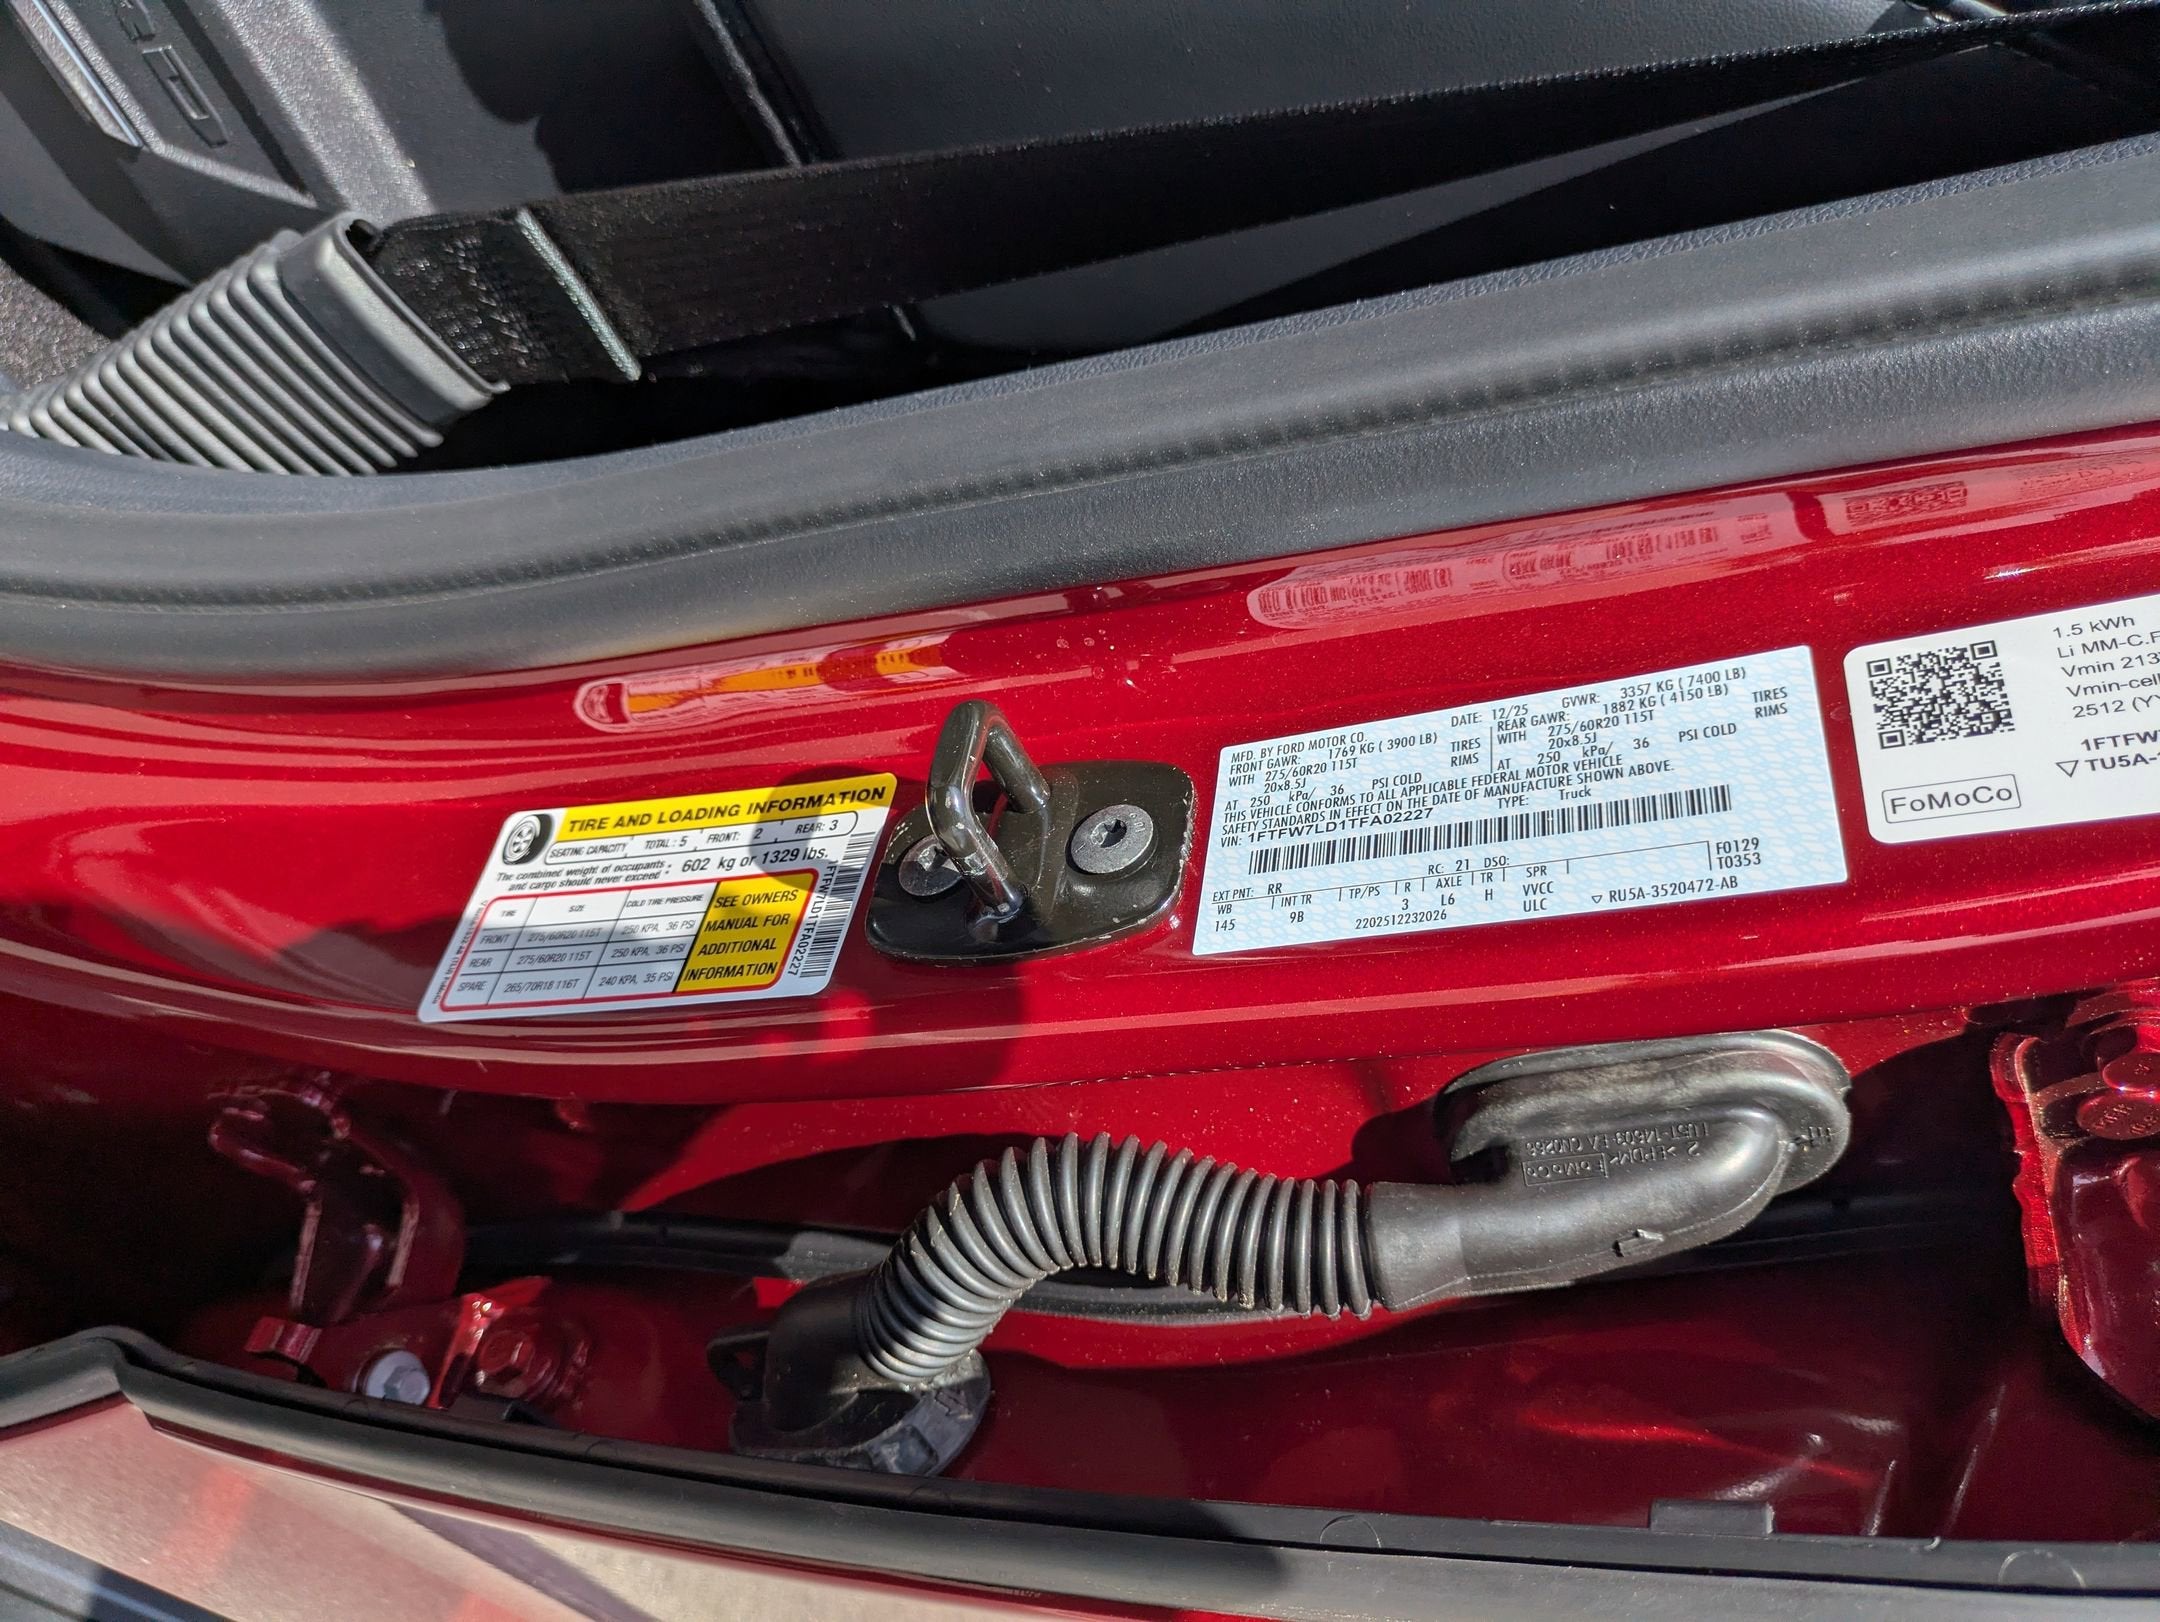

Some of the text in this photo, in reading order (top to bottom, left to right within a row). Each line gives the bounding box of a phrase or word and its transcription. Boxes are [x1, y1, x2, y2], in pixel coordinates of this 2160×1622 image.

[2053, 616, 2135, 638] 1.5 kWh
[2058, 645, 2074, 658] Li
[2061, 652, 2160, 677] Vmin 213
[1562, 667, 1746, 708] GVWR: 3357 KG 7400 LB)
[1451, 704, 1528, 727] DATE: 12/25
[1497, 684, 1729, 732] REAR GAWR: 1882 KG 4150 LB)
[1497, 687, 1788, 745] WITH 275/60R20 115T TIRES
[2073, 700, 2125, 718] 2512
[1549, 703, 1788, 750] 20x8.5J RIMS
[1230, 732, 1438, 775] FRONT GAWR: 1769 KG 3900 LB)
[1231, 732, 1367, 763] MFD. BY FORD MOTOR CO.
[1498, 723, 1737, 771] AT 250 kPa/ 36 PSI COLD
[2081, 730, 2160, 751] 1FTFW
[1229, 738, 1481, 787] WITH 275/60R20 115T TIRES
[1264, 753, 1479, 794] 20x8.5J RIMS
[2085, 753, 2160, 771] TU5A-
[1222, 760, 1674, 836] SAFETY STANDARDS IN EFFECT ON THE DATE OF MANUFACTURE SHOWN ABOVE.
[1224, 754, 1623, 824] THIS VEHICLE CONFORMS TO ALL APPLICABLE FEDERAL MOTOR VEHICLE
[1225, 773, 1422, 812] AT 250 kPa/ 36 PSI COLD
[1498, 785, 1591, 809] TYPE: Truck
[1890, 785, 2013, 815] FoMoCo
[569, 787, 886, 832] TIRE AND LOADING INFORMATION
[678, 836, 688, 847] 5
[707, 832, 741, 844] FRONT:
[753, 828, 763, 839] 2
[795, 823, 825, 834] REAR:
[829, 820, 839, 831] 3
[1221, 808, 1433, 848] VIN: 1FTFW7LD1TFA02227
[1716, 837, 1760, 854] F0129
[497, 861, 665, 881] The combined weight occupants
[682, 847, 828, 873] 602 kg or 1329 lbs.
[1718, 852, 1761, 870] T0353
[508, 871, 660, 891] and cargo should never exceed
[1213, 856, 1510, 902] EXT PNT: RR RC: 21 DSO:
[1217, 865, 1548, 915] WB INT TR TP/PS AXLE TR SPR
[1609, 876, 1738, 903] RU5A-3520472-AB
[714, 890, 798, 908] SEE OWNERS
[1215, 881, 1554, 932] 145 9B 2202512232026 3 L6 VVCC
[1523, 898, 1548, 912] ULC
[704, 913, 791, 932] MANUAL FOR
[469, 958, 492, 967] REAR
[611, 948, 629, 958] 250
[671, 943, 685, 953] PSI
[697, 938, 777, 956] ADDITIONAL
[457, 981, 487, 991] SPARE
[599, 976, 616, 987] 240
[644, 972, 656, 983] 35
[657, 971, 674, 981] PSI
[684, 962, 779, 981] INFORMATION
